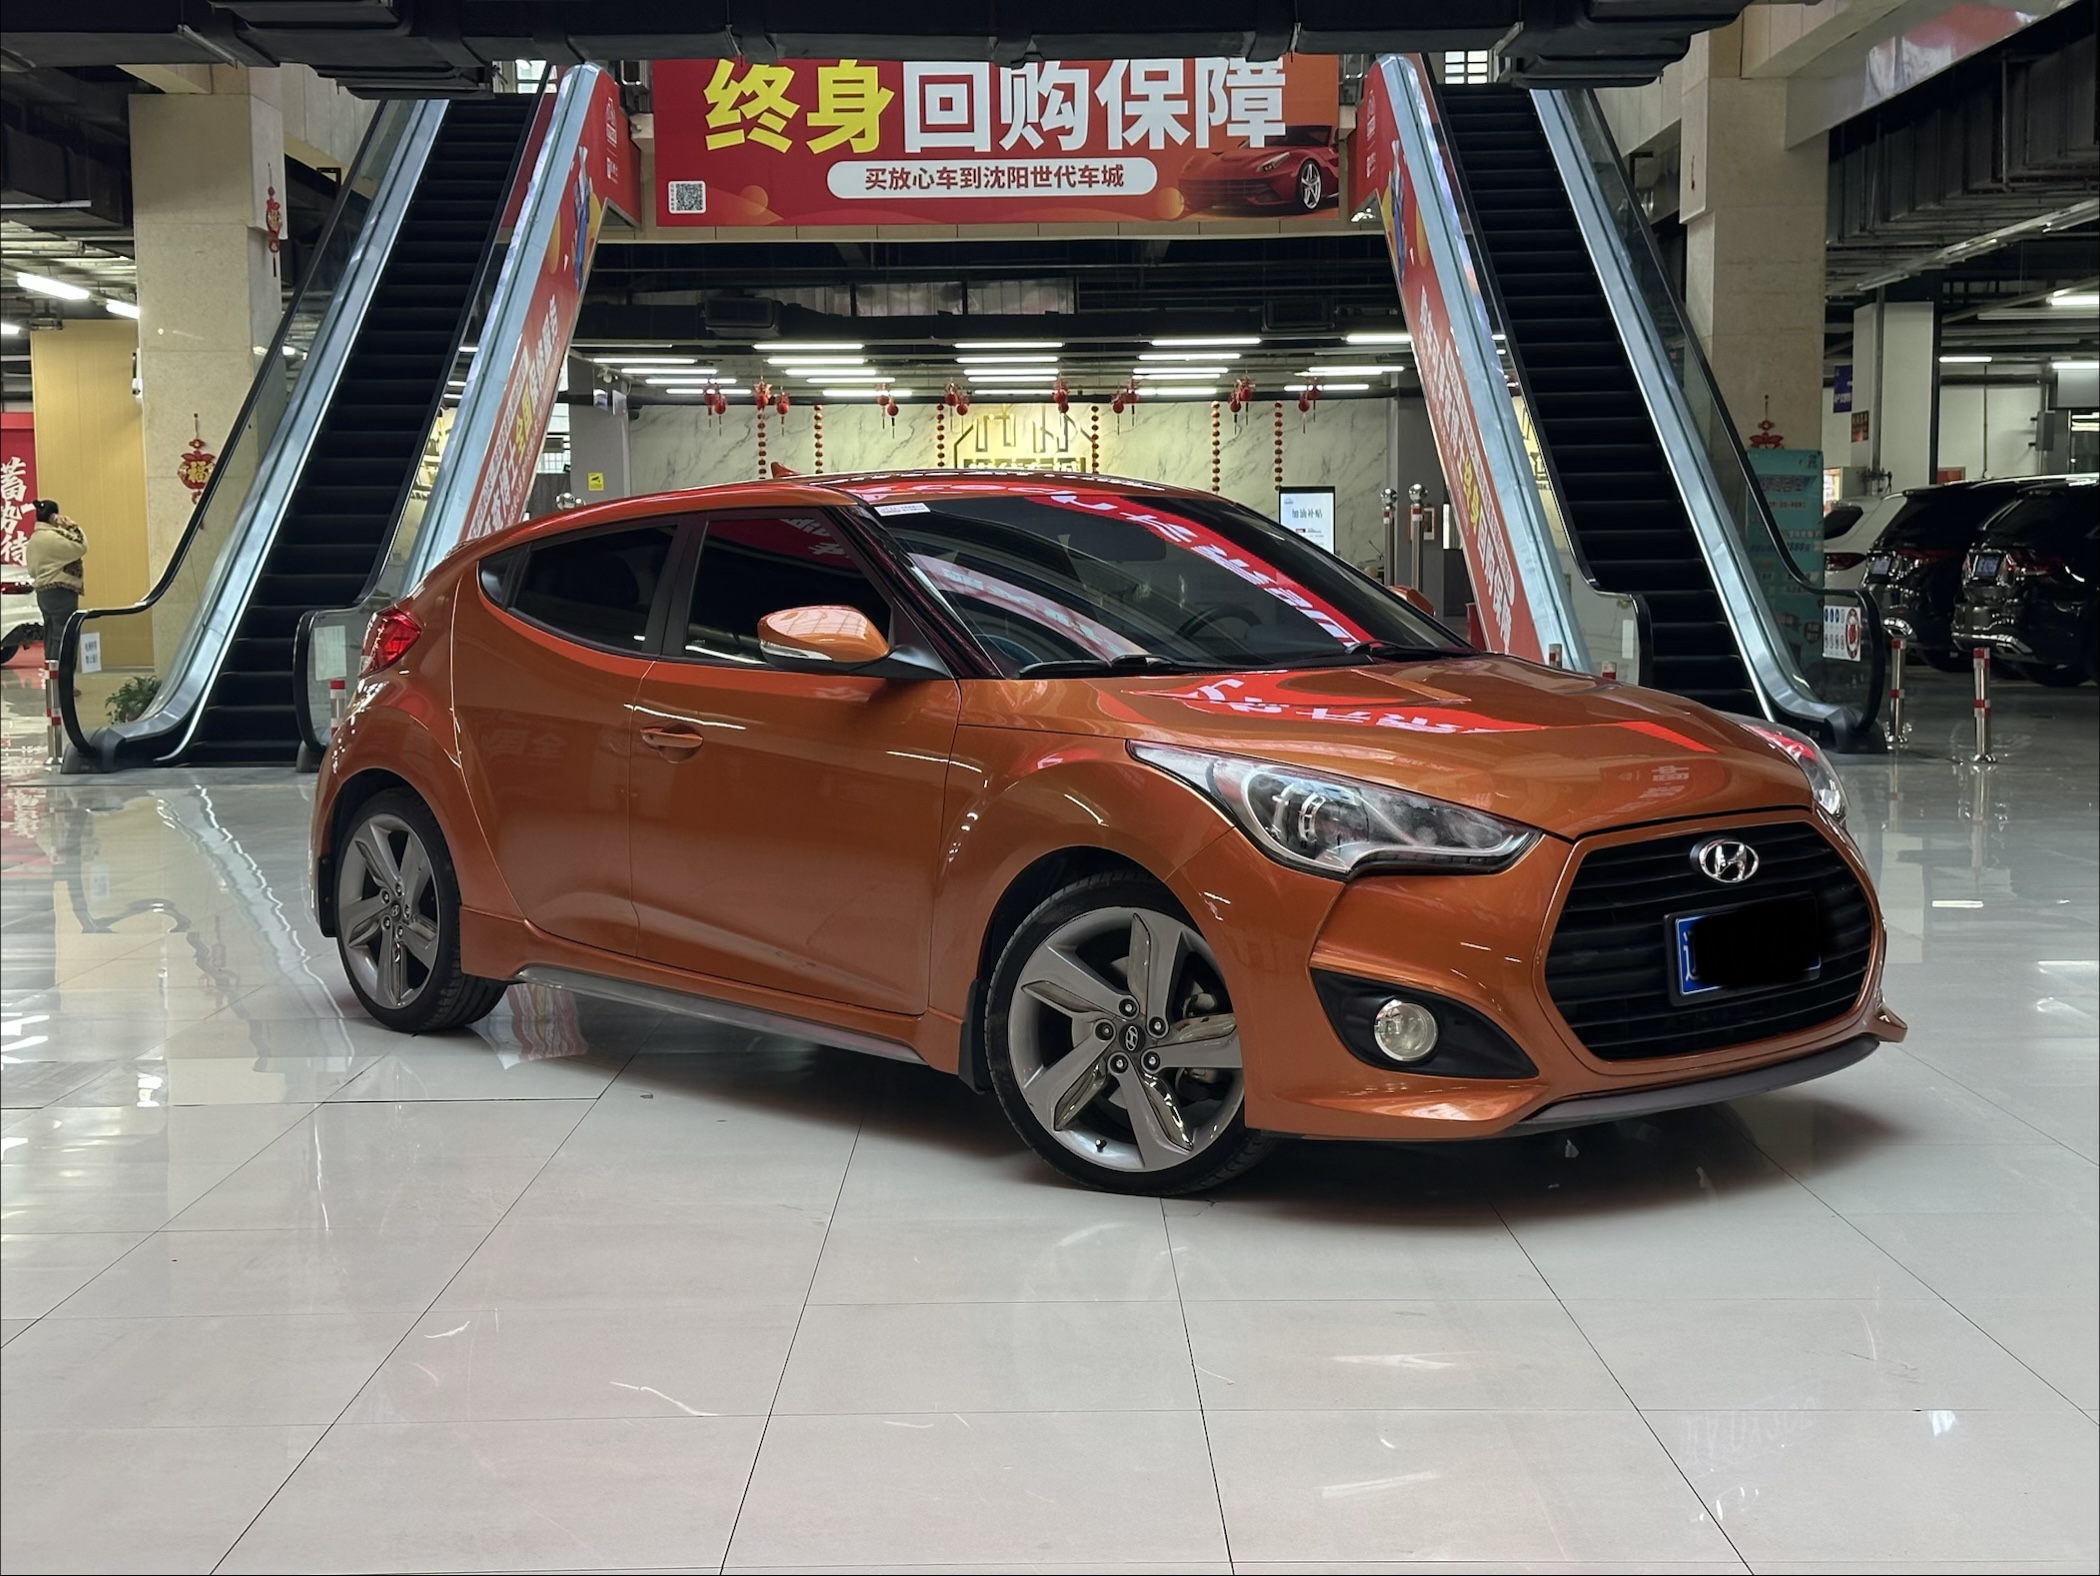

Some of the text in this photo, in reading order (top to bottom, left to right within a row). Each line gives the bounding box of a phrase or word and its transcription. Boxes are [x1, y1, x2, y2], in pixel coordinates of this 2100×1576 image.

[703, 57, 1286, 154] 终身回购保障
[865, 164, 1125, 190] 买放心车到沈阳世代车城
